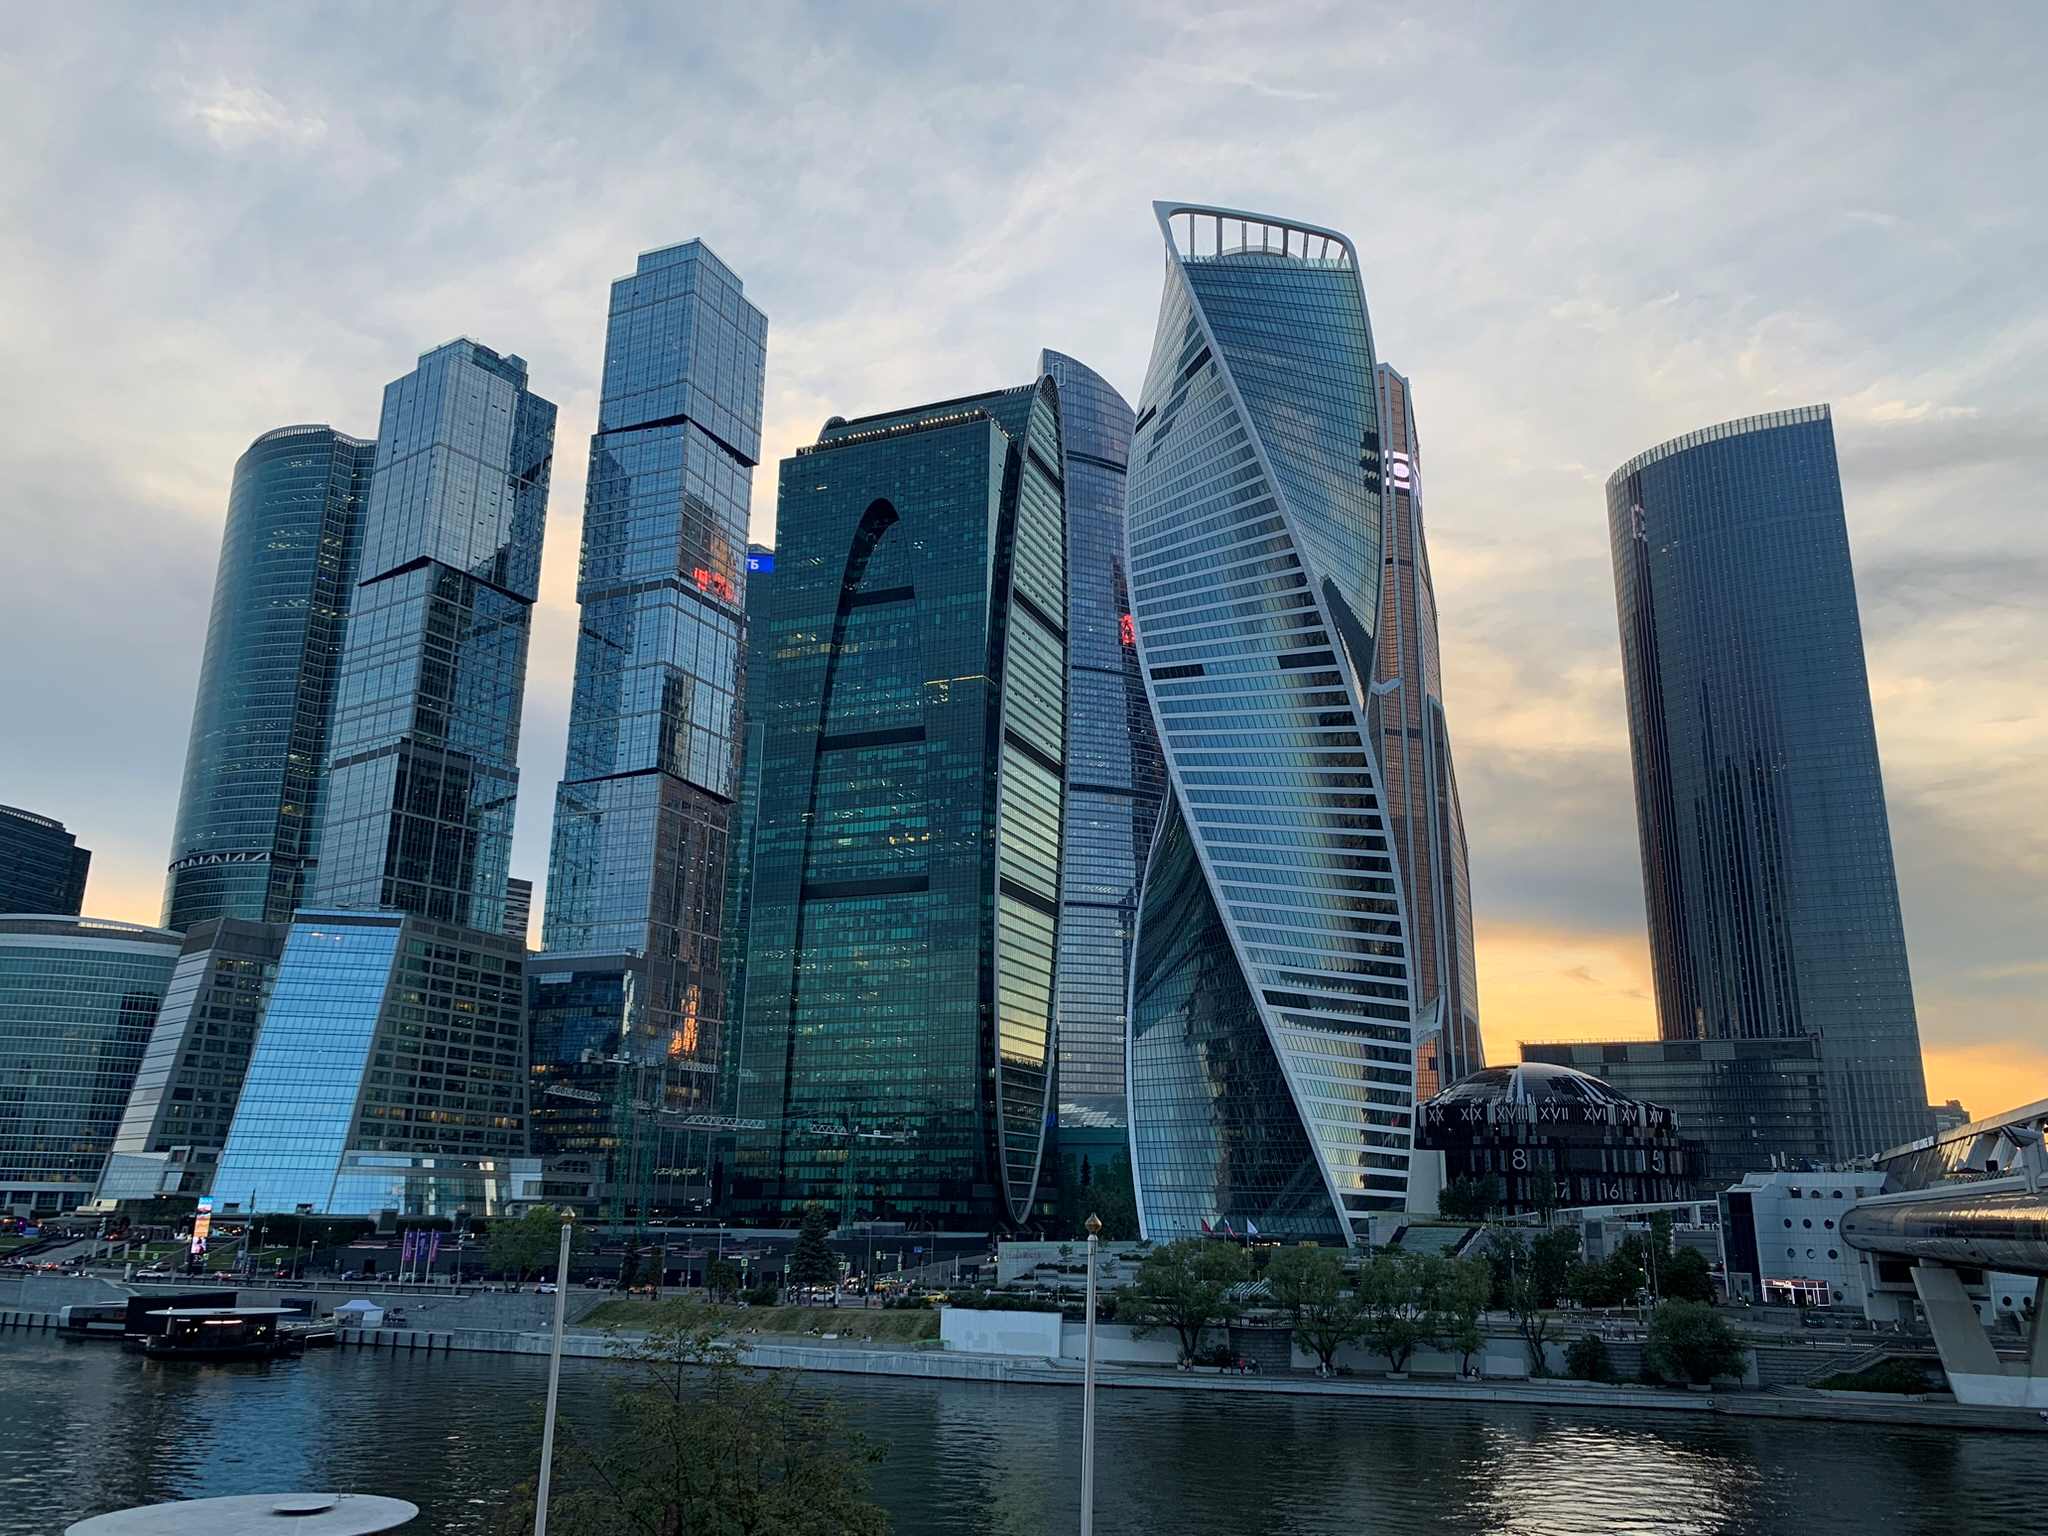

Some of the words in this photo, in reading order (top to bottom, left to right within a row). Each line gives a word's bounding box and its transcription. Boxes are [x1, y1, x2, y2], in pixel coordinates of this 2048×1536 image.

[1428, 1106, 1445, 1121] XX
[1460, 1107, 1482, 1121] XIX
[1496, 1106, 1528, 1121] XVIII
[1540, 1106, 1569, 1121] XVII
[1583, 1107, 1607, 1121] XVI
[1622, 1108, 1638, 1121] XV
[1649, 1109, 1664, 1124] XIV
[1601, 1182, 1620, 1200] 16
